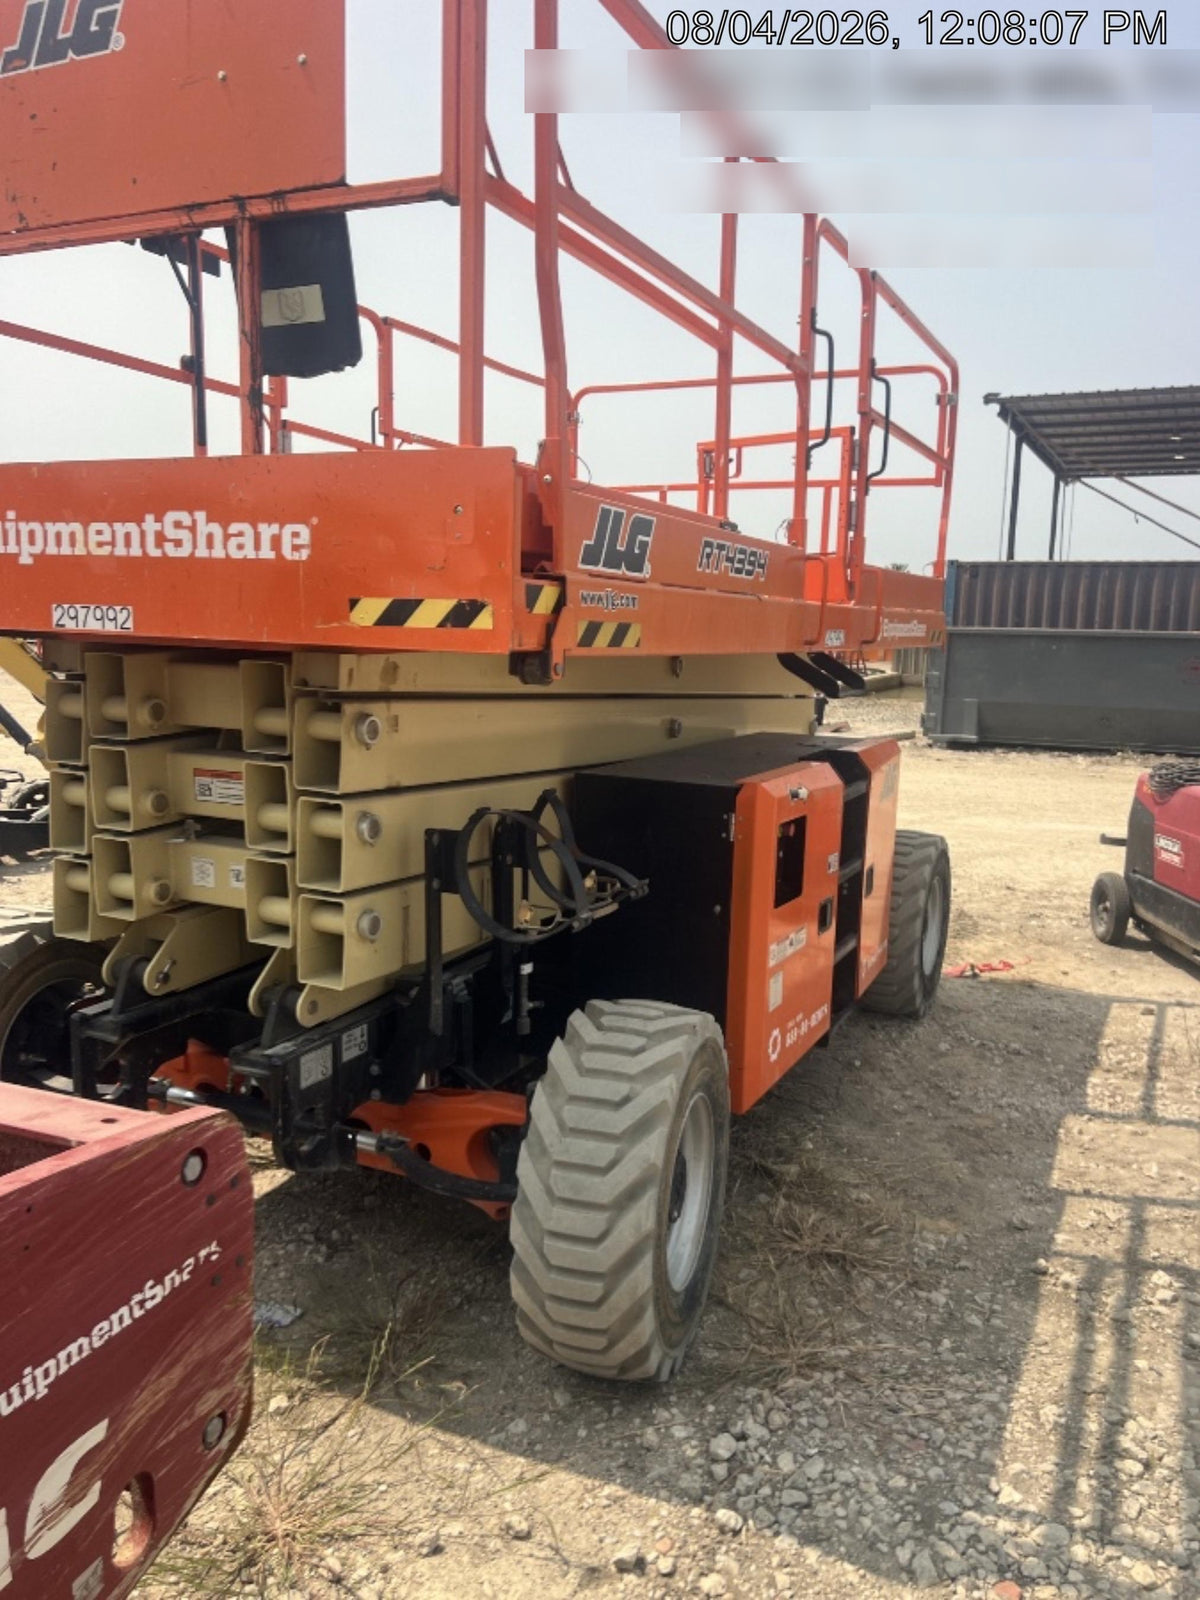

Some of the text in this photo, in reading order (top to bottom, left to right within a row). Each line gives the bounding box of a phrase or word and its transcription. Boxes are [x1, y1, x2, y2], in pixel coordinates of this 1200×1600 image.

[0, 0, 124, 78] JLG
[578, 504, 656, 578] JLG
[697, 537, 768, 581] RT4394
[54, 605, 131, 630] 297992
